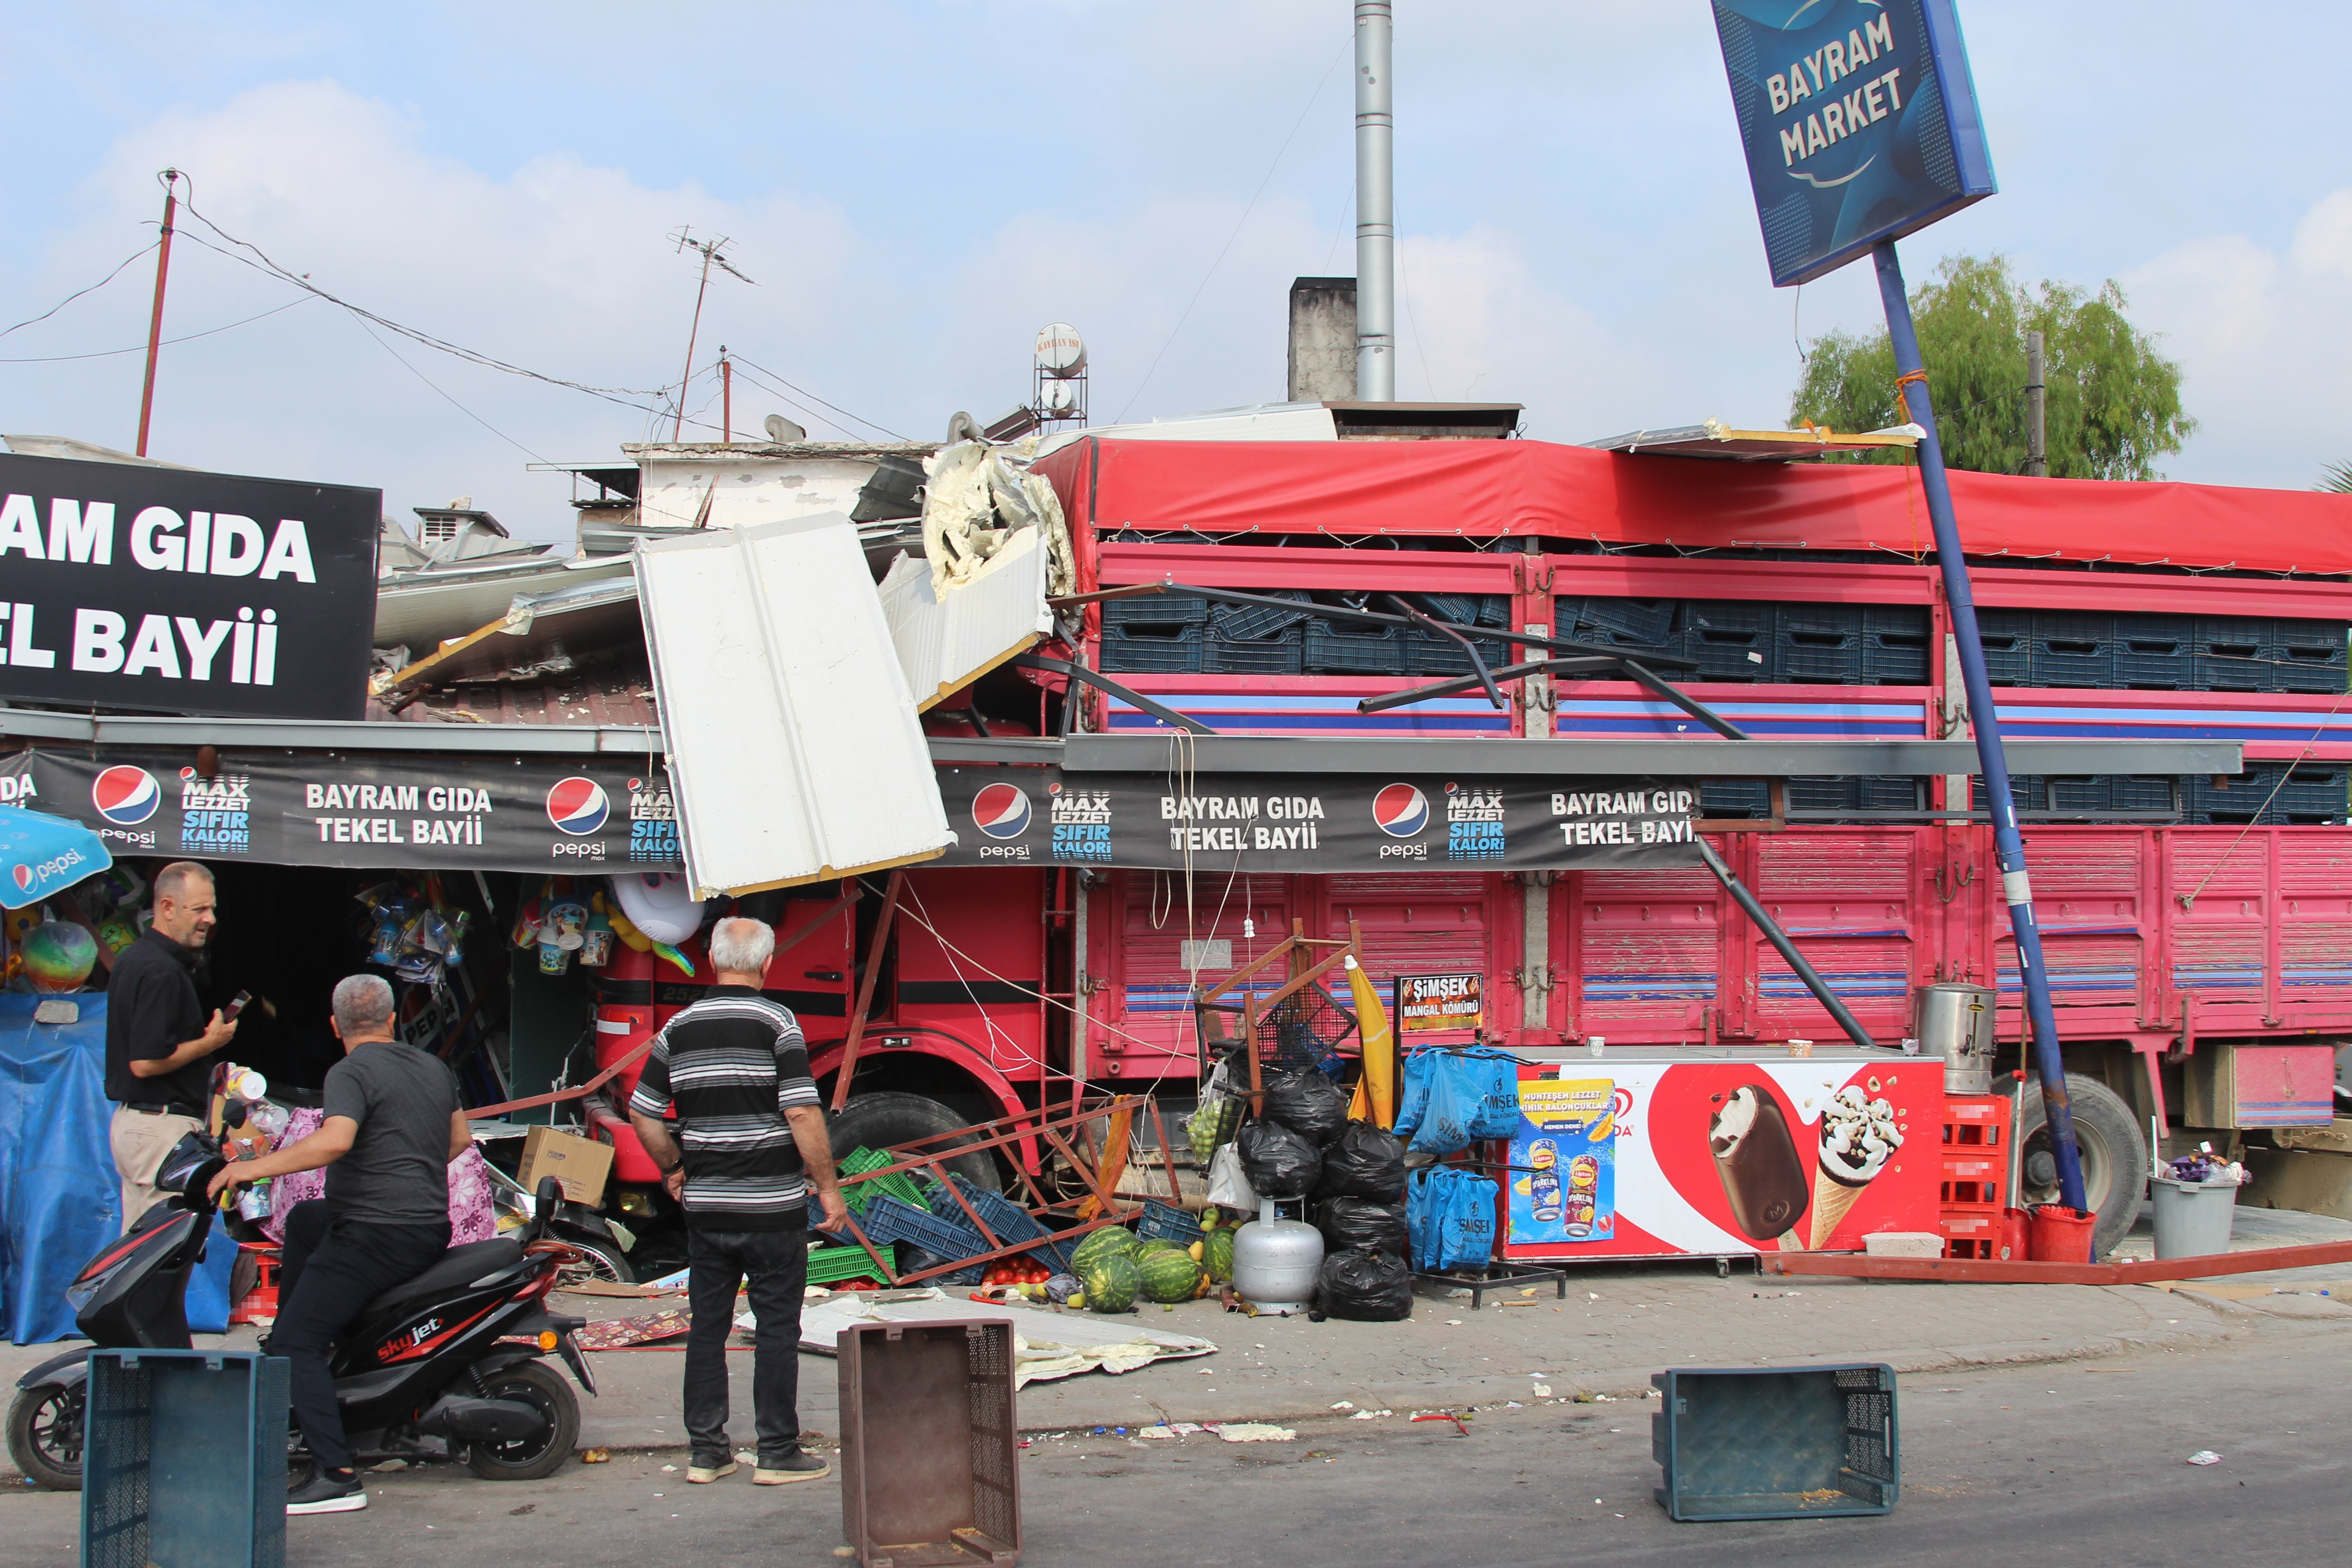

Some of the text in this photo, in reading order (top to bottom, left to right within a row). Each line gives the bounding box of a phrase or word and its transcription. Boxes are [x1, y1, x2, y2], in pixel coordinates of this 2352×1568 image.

[1767, 12, 1895, 115] BAYRAM
[1779, 68, 1901, 167] MARKET
[130, 506, 316, 583] GIDA
[0, 601, 56, 669] L
[182, 782, 250, 797] MAX
[182, 796, 252, 811] LEZZET
[307, 784, 493, 813] BAYRAM GIDA
[630, 793, 674, 807] MA
[1051, 798, 1111, 811] MAX
[1447, 796, 1503, 809] MAX
[1551, 791, 1646, 815] BAYRAM
[630, 807, 676, 820] LEZZ
[1161, 796, 1325, 820] BAYRAM GIDA
[1447, 808, 1505, 822] LEZZET
[182, 811, 250, 829] SIFIR
[1051, 811, 1112, 824] LEZZET
[101, 828, 156, 848] pepsi
[316, 815, 483, 845] TEKEL BAYİİ
[1053, 824, 1111, 841] SIFIR
[1171, 823, 1318, 851] TEKEL BAYİİ
[1449, 822, 1504, 838] SIFIR
[1559, 822, 1635, 846] TEKEL
[552, 841, 607, 859] pepsi
[980, 844, 1030, 859] pepsi
[1380, 842, 1427, 860] pepsi
[37, 848, 83, 883] pepsi
[1404, 1000, 1478, 1017] MANGAL KÖMÜRÜ
[1524, 1091, 1601, 1102] MUHTEŞEM LEZZET
[1546, 1102, 1608, 1112] BALONCUKLAR
[1533, 1178, 1558, 1189] SPARKLING
[1568, 1193, 1593, 1205] SPARKLING
[377, 1318, 440, 1360] skyjet
